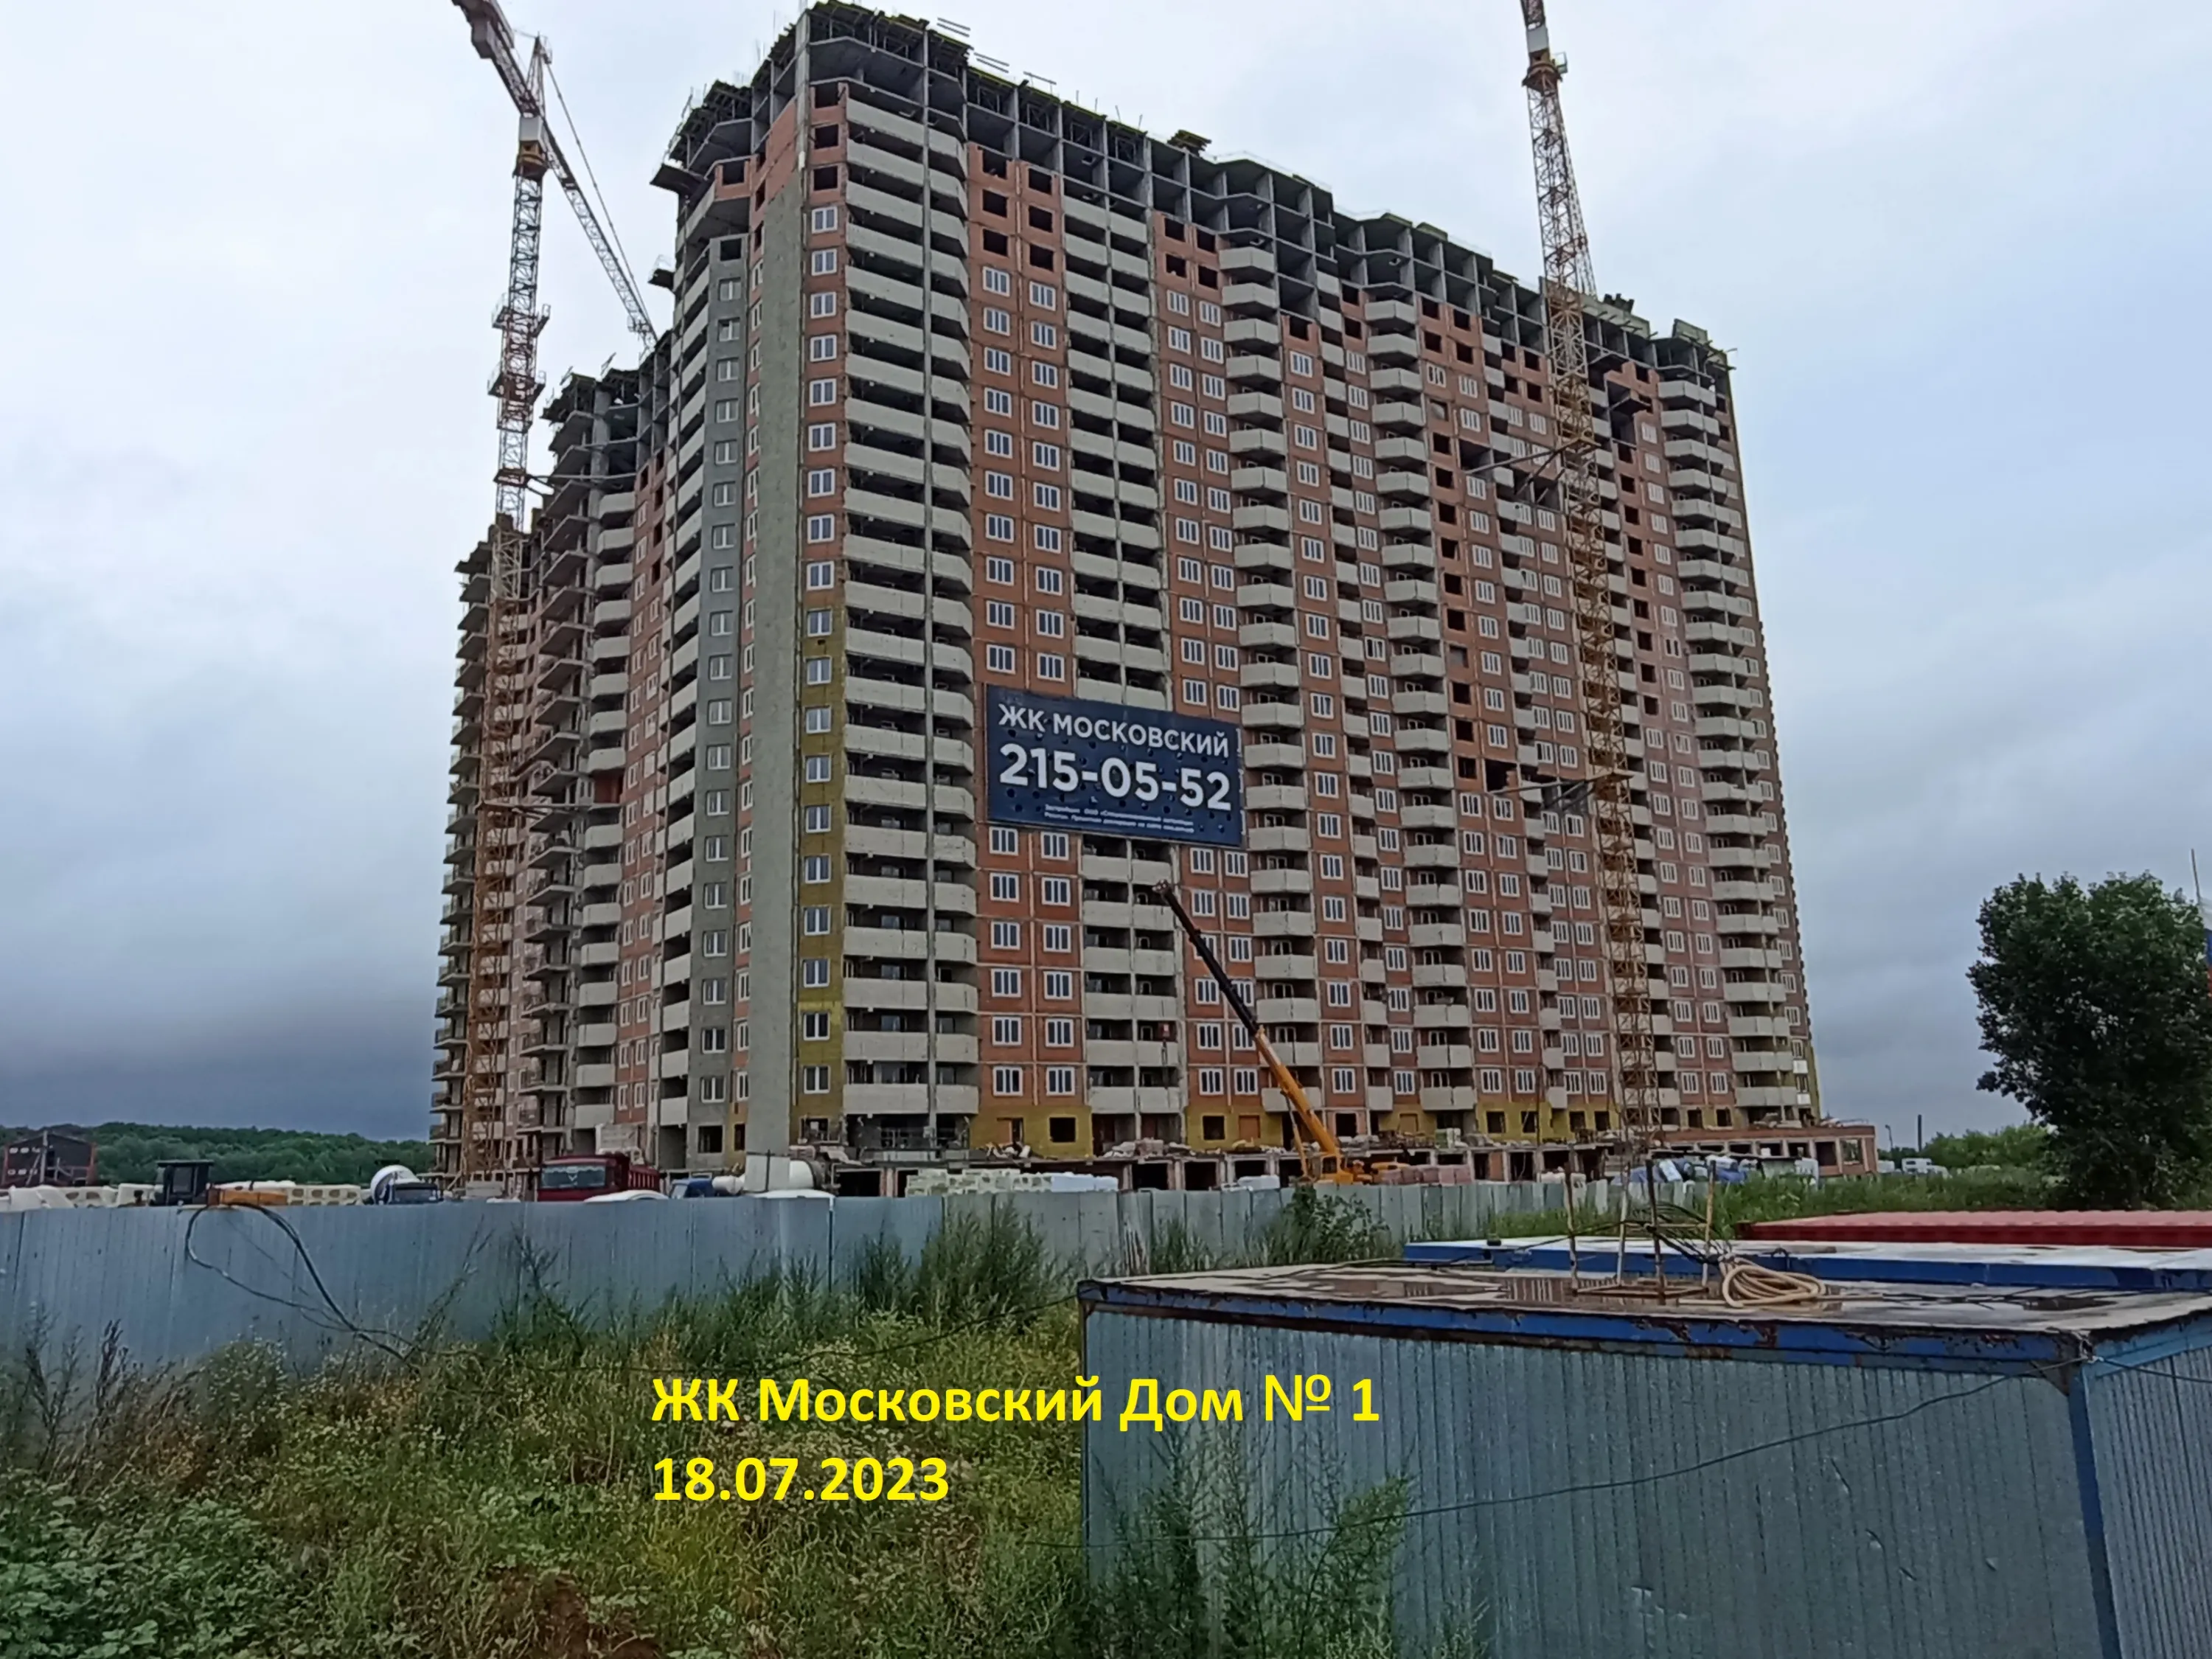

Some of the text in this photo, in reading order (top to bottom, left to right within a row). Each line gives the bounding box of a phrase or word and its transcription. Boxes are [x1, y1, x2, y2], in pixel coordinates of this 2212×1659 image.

[998, 703, 1229, 758] ЖК МОСКОВСКИЙ
[999, 742, 1231, 811] 215-05-52
